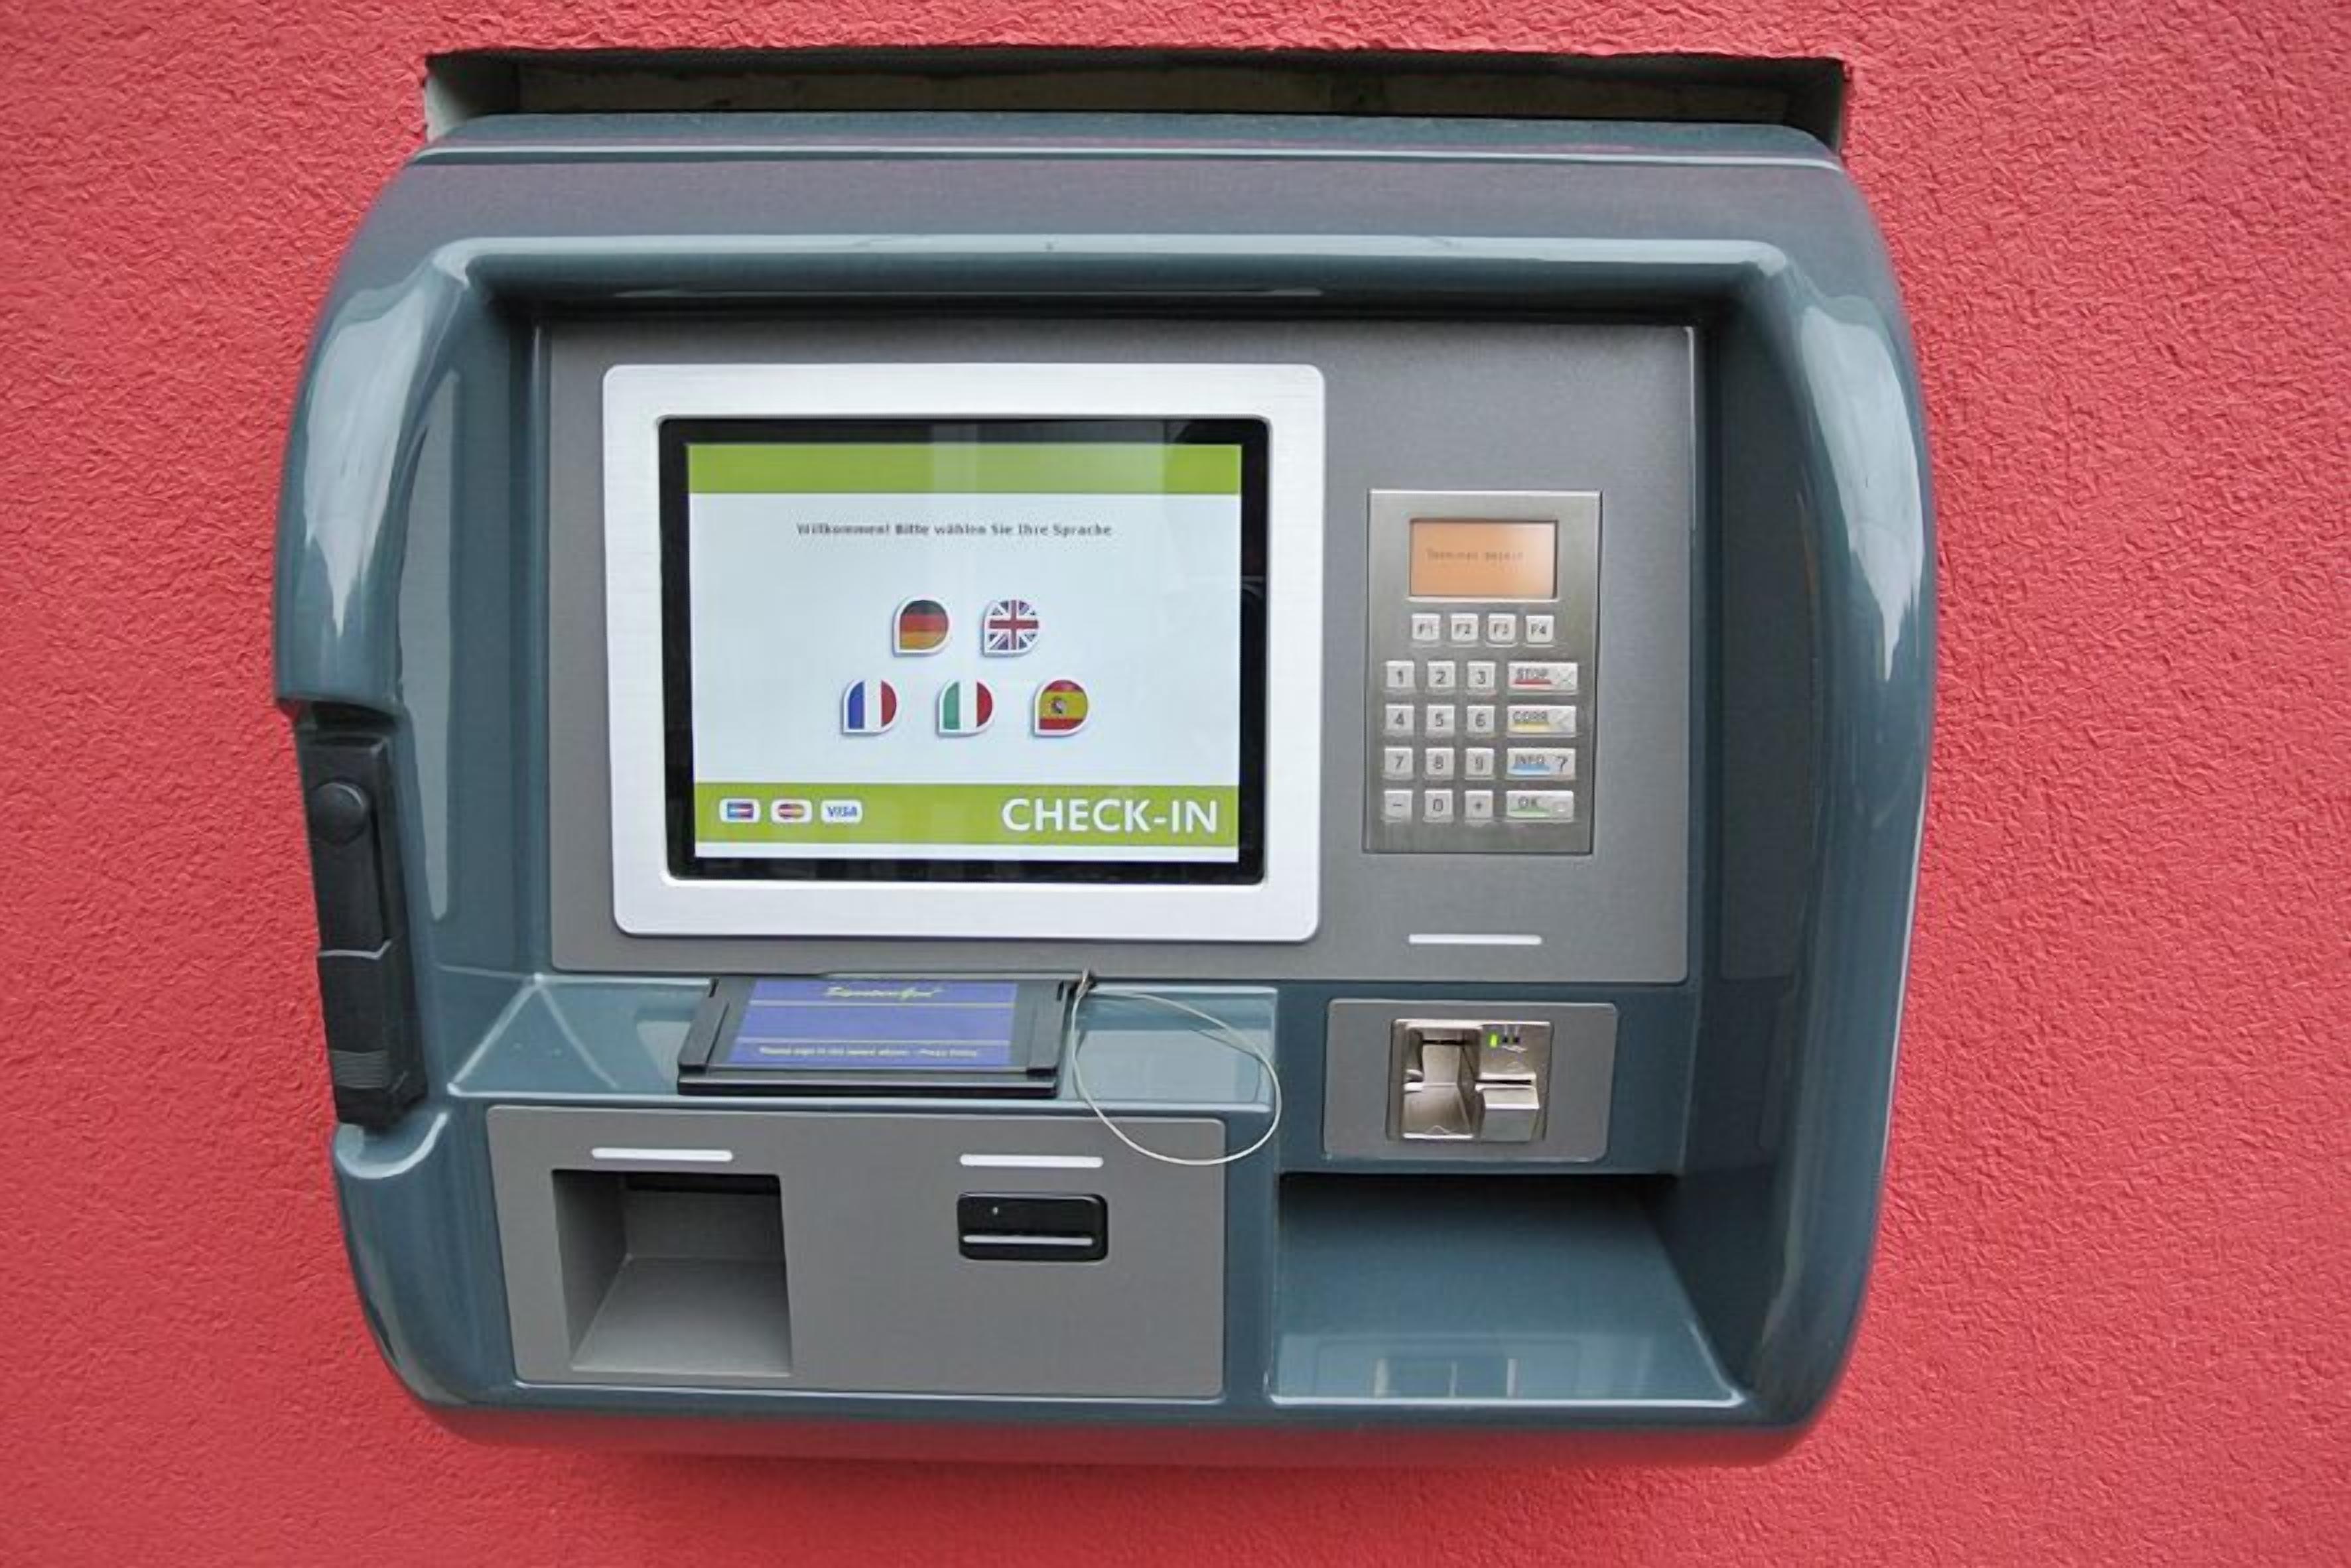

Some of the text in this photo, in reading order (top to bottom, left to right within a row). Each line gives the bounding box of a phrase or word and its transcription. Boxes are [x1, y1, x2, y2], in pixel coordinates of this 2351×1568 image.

[991, 523, 1013, 536] Sie
[1053, 523, 1112, 538] Sprache
[1418, 623, 1434, 635] F1
[1456, 623, 1471, 635] F2
[1493, 623, 1509, 635] F3
[1530, 623, 1548, 635] F4
[1396, 670, 1404, 684] 1
[1436, 670, 1446, 685] 2
[1477, 671, 1486, 685] 3
[1395, 712, 1405, 726] 4
[1435, 713, 1444, 727] 5
[1476, 713, 1486, 727] 6
[1395, 755, 1404, 769] 7
[1434, 755, 1444, 770] 8
[1475, 755, 1484, 770] 9
[827, 806, 858, 817] VISA
[1433, 798, 1444, 813] 0
[1001, 797, 1218, 833] CHECK-IN
